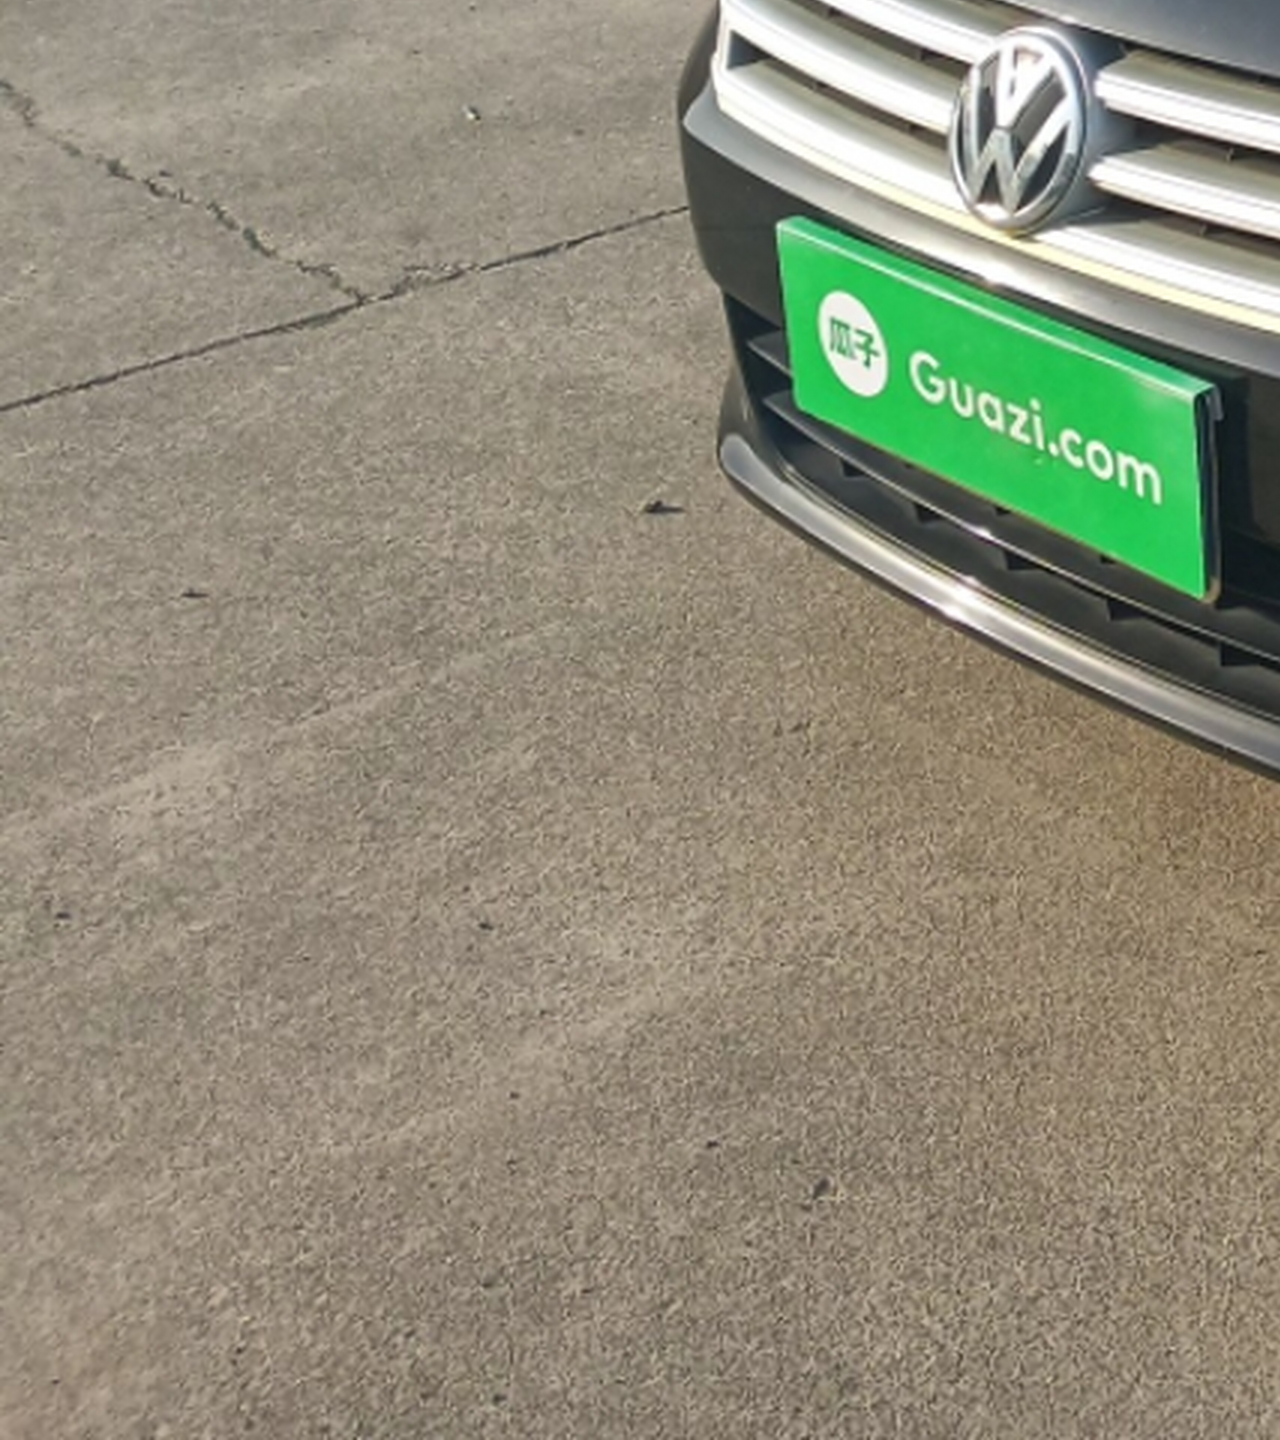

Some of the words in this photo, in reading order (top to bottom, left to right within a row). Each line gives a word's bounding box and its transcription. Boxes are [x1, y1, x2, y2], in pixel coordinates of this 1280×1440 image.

[962, 30, 1084, 225] VW
[829, 316, 880, 369] 瓜子
[908, 351, 1163, 504] Guazi.com
